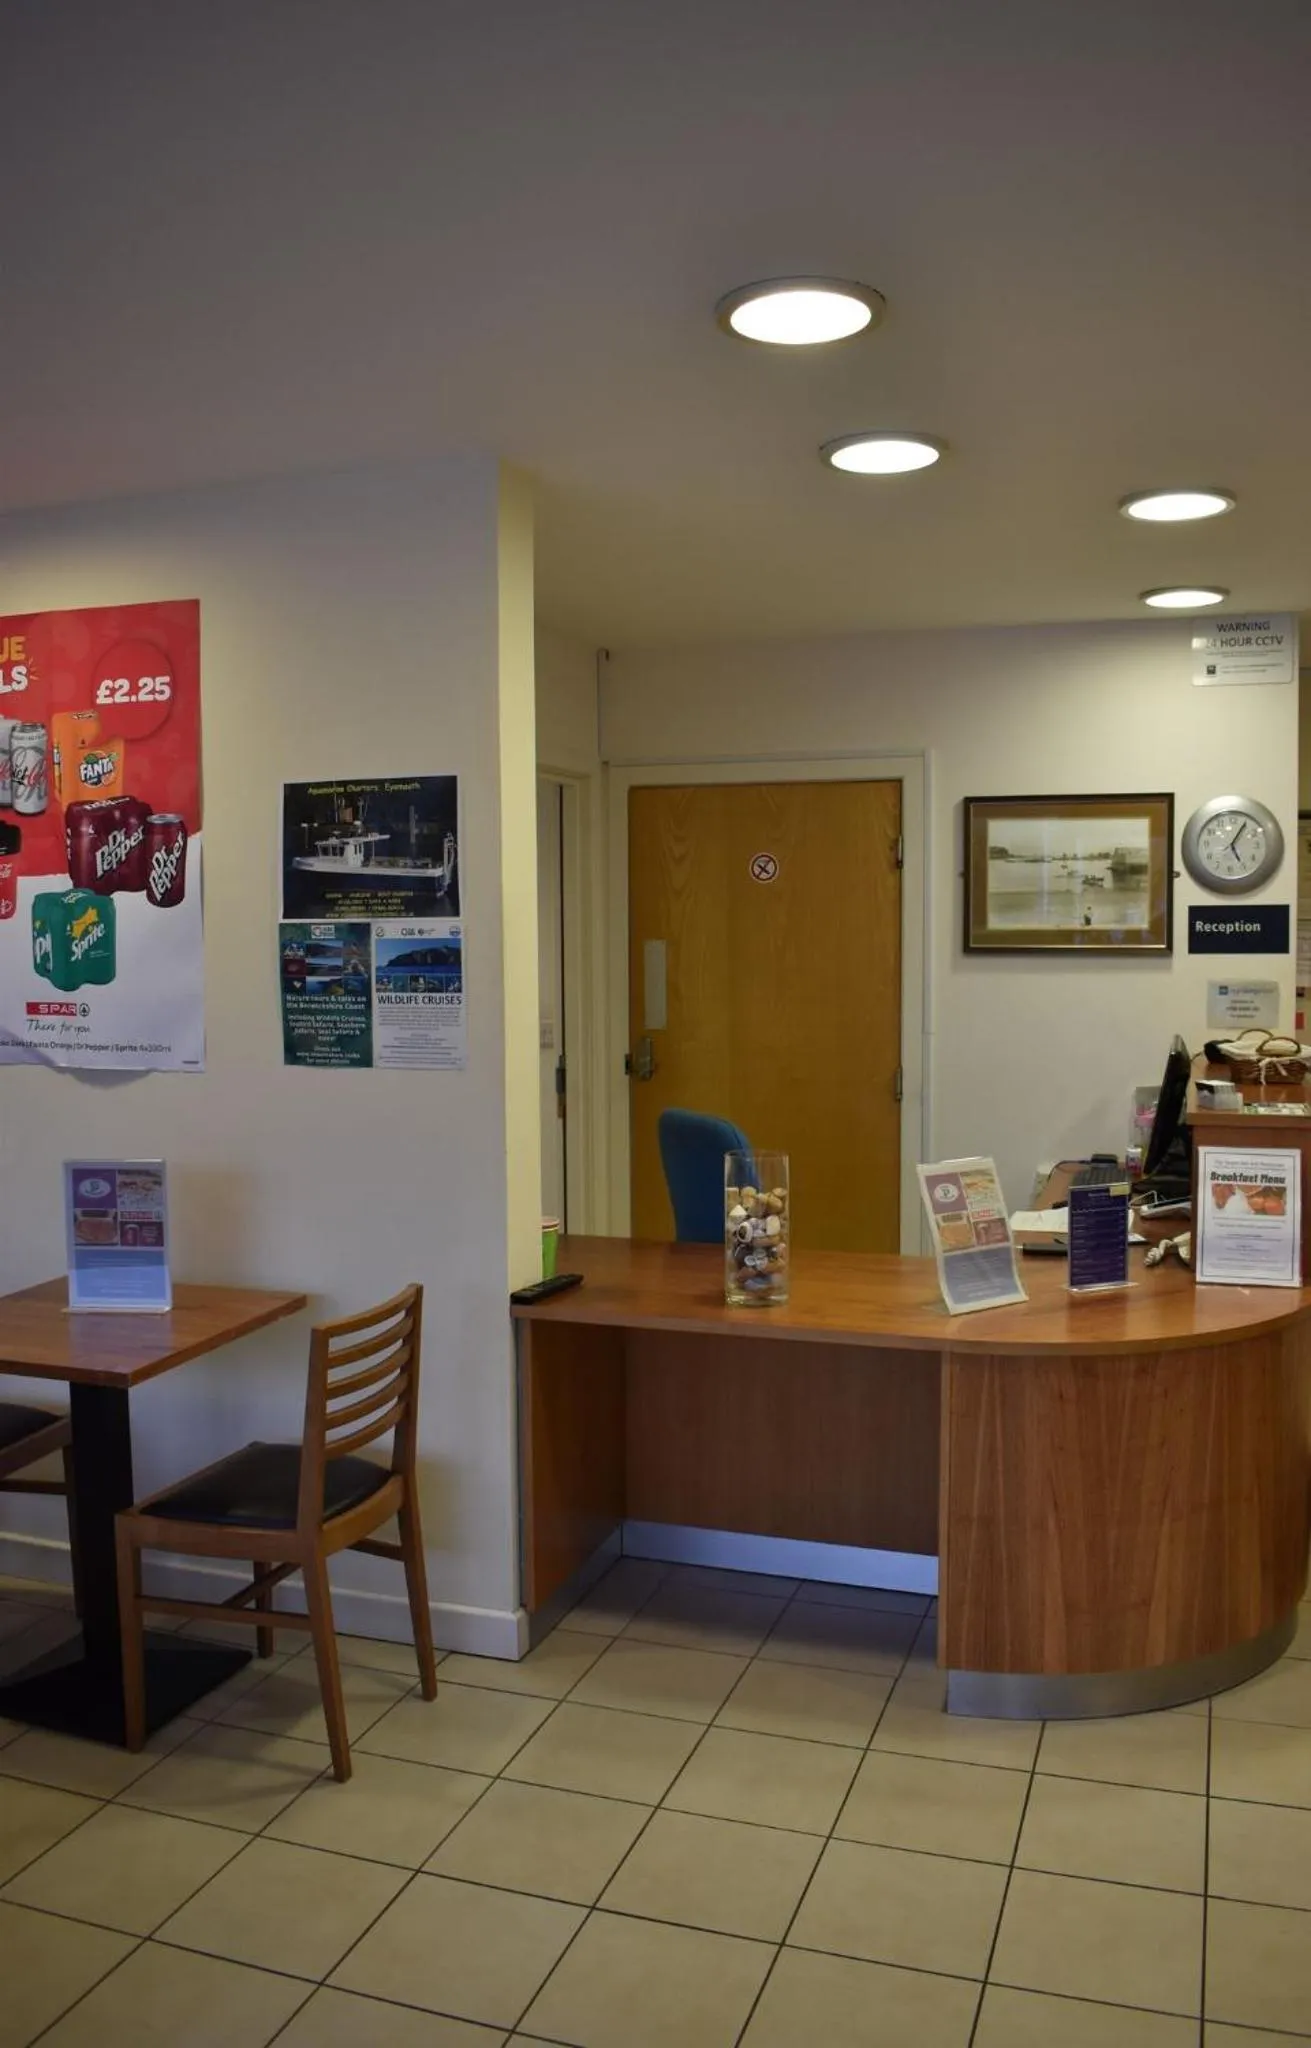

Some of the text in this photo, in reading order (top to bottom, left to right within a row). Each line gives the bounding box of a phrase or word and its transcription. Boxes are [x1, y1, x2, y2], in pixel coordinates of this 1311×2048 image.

[1217, 621, 1270, 632] WARNING
[1220, 636, 1253, 647] HOUR
[1255, 635, 1284, 646] CCTV
[96, 676, 171, 704] £2.25
[79, 757, 114, 781] FANTA
[108, 827, 127, 851] Dr
[96, 825, 144, 879] Pepper
[151, 845, 169, 872] Dr
[149, 831, 184, 902] Pepper
[1195, 920, 1261, 934] Reception
[70, 923, 106, 962] Sprite
[39, 1004, 77, 1014] SPAR
[377, 995, 462, 1005] WILDLIFE CRUISES
[27, 1019, 56, 1032] There
[74, 1026, 91, 1038] you
[1210, 1171, 1286, 1184] Breakfast Menu
